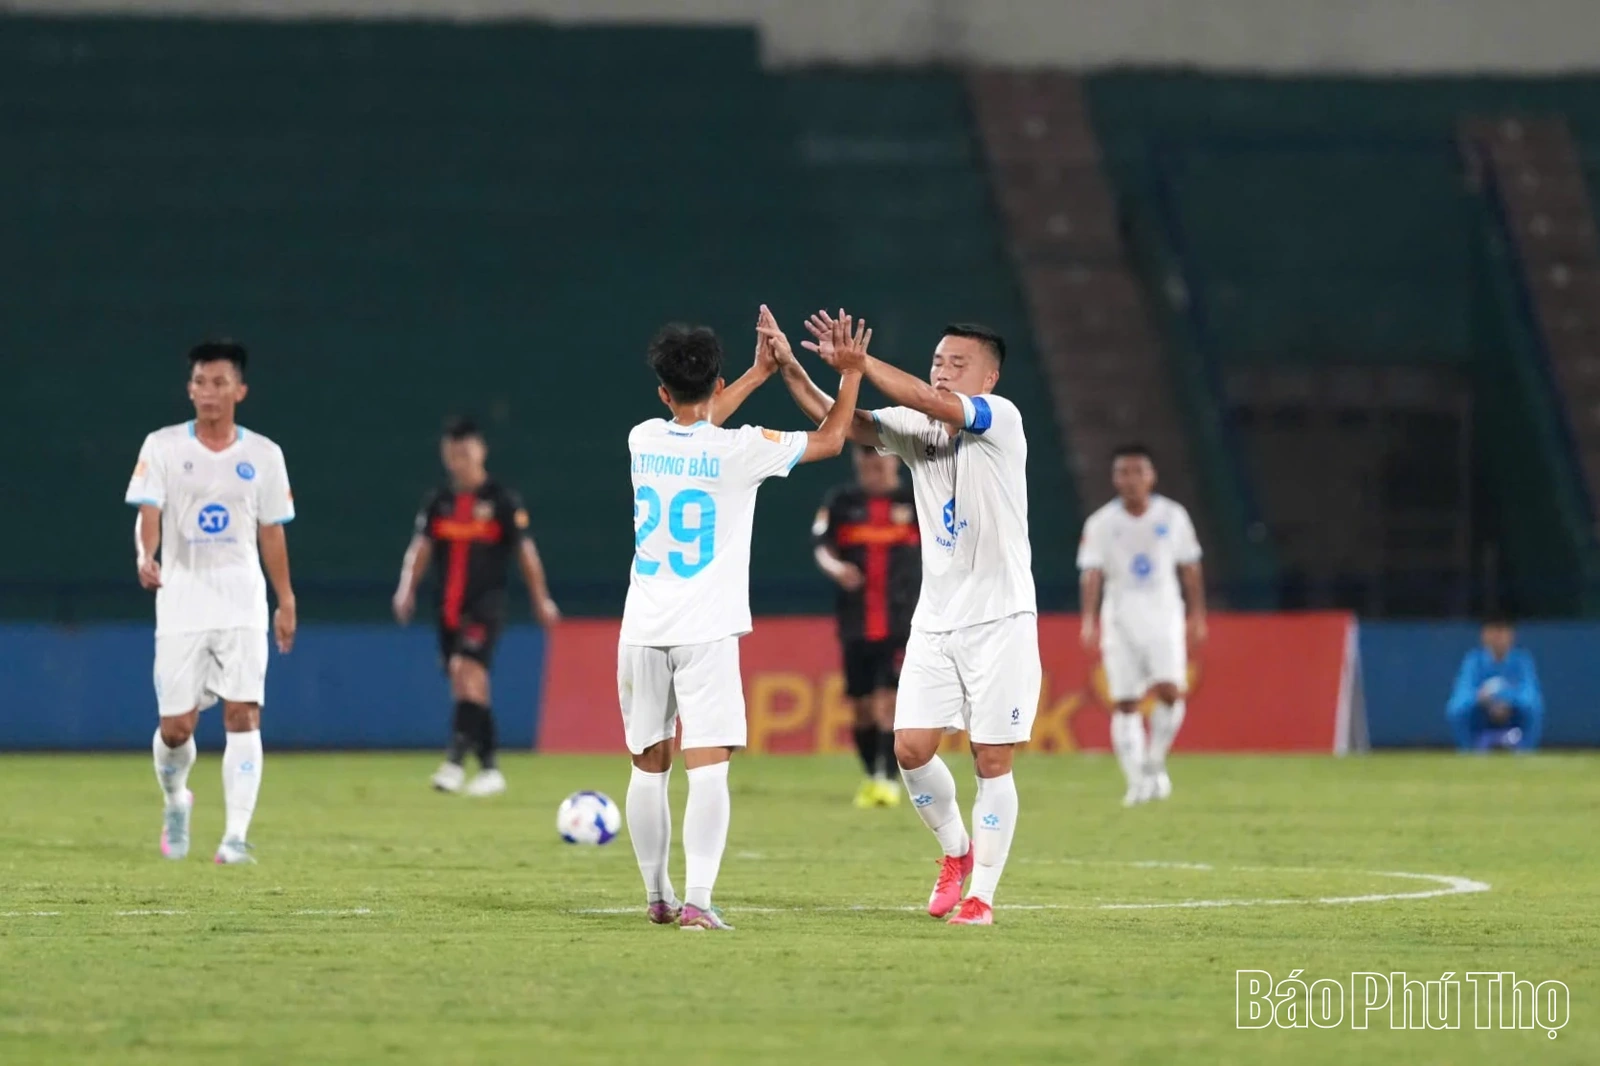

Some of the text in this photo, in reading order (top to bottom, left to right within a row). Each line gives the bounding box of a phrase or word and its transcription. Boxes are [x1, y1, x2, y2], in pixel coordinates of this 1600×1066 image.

[633, 453, 685, 477] .TRỌNG
[201, 510, 227, 529] XT
[634, 485, 716, 579] 29
